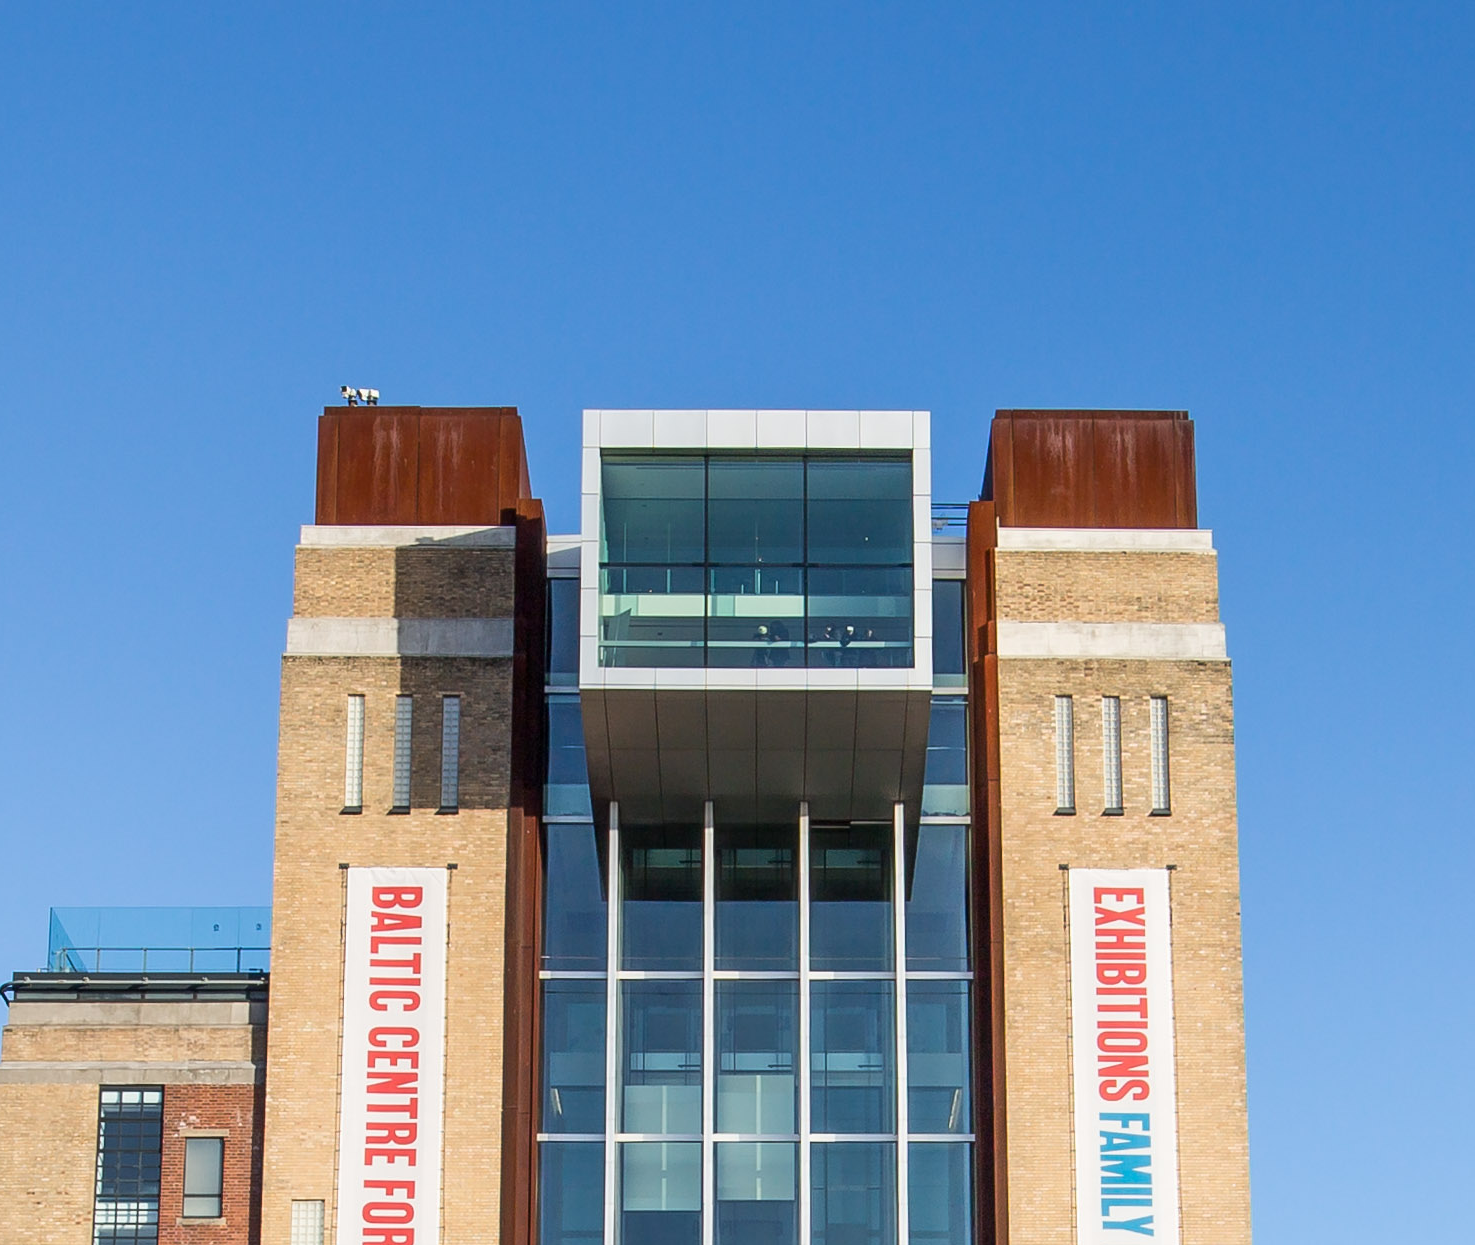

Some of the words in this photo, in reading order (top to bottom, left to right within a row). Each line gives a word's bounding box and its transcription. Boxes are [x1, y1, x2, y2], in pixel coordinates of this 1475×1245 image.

[370, 886, 423, 1012] BALTIC
[1093, 887, 1150, 1102] EXHIBITIONS
[364, 1026, 420, 1167] CENTRE
[1099, 1112, 1154, 1236] FAMILY
